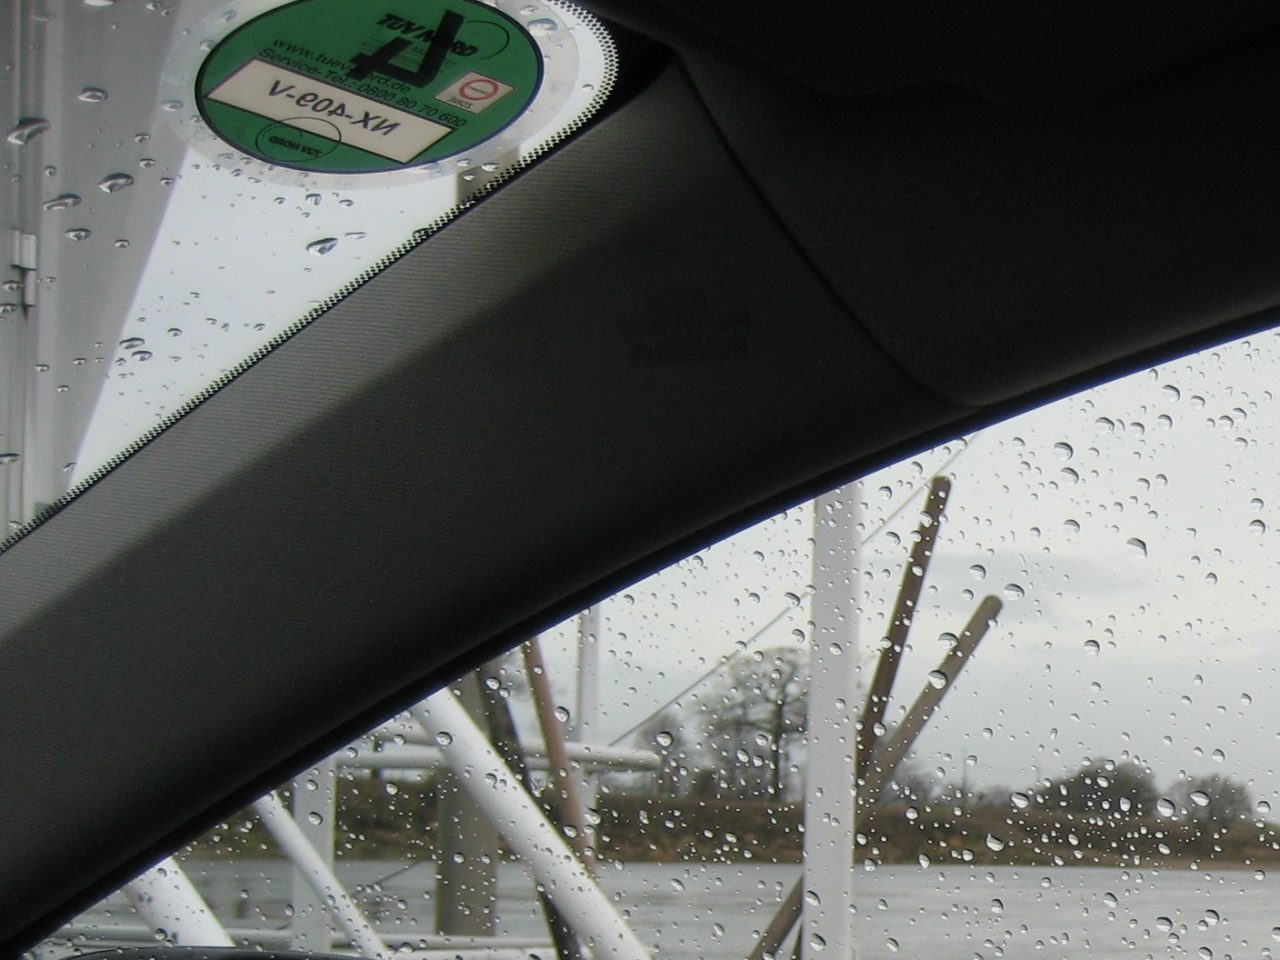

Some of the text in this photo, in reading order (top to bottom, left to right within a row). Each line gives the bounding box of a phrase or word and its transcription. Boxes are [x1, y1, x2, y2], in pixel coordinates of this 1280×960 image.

[413, 28, 479, 57] NRD
[358, 83, 396, 101] 0800
[397, 97, 417, 109] 80
[419, 104, 439, 116] 70
[438, 112, 467, 127] 600
